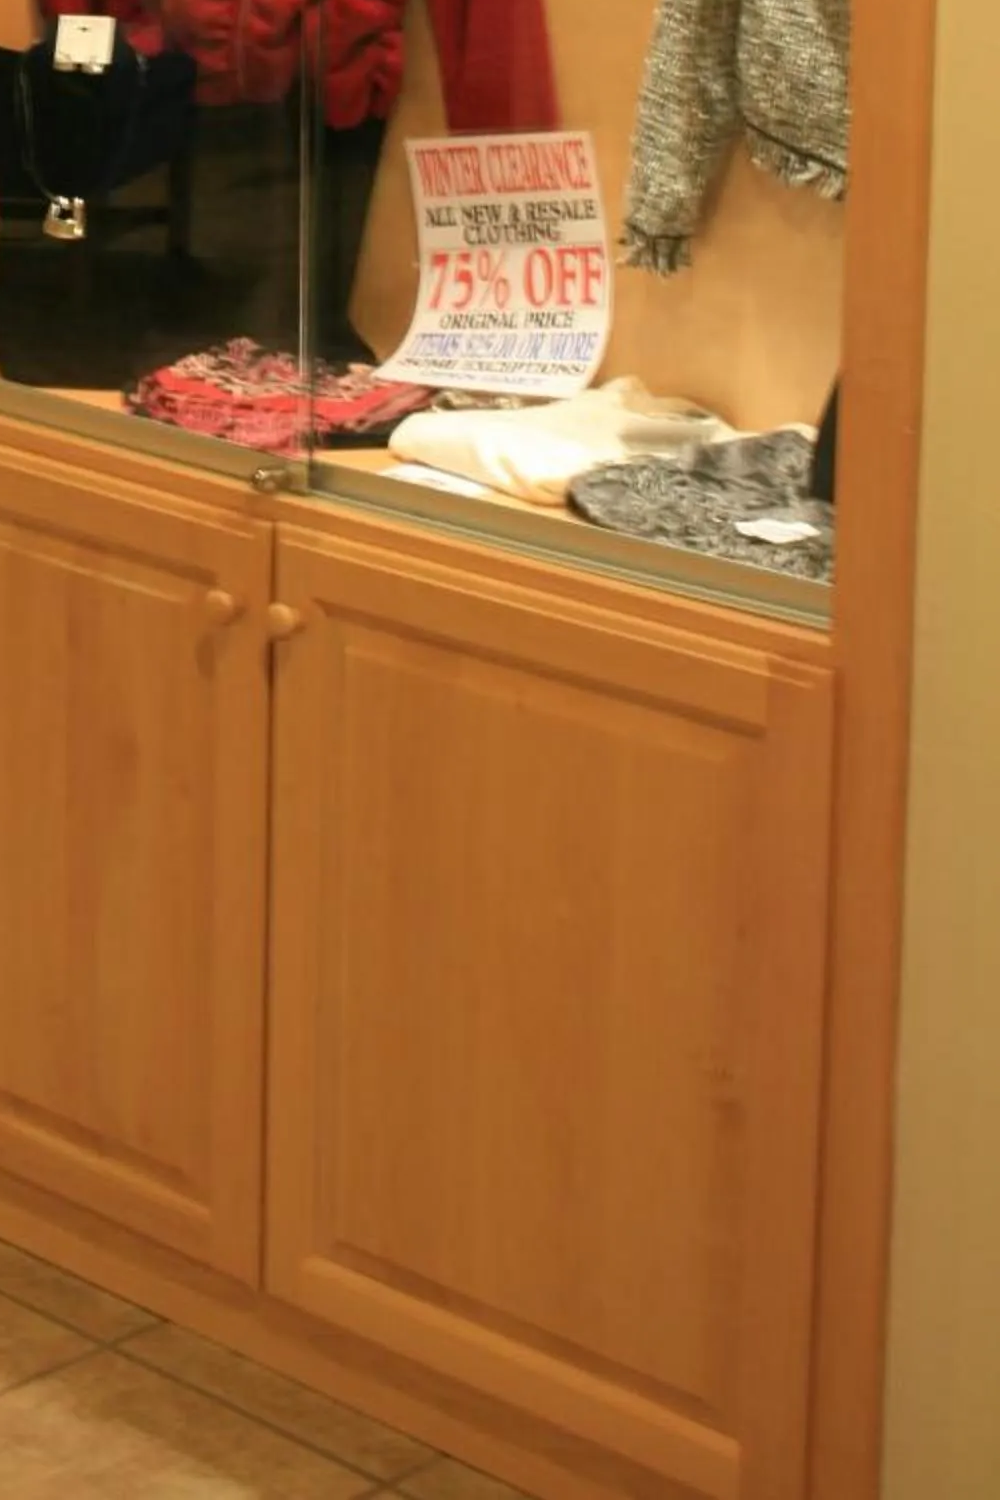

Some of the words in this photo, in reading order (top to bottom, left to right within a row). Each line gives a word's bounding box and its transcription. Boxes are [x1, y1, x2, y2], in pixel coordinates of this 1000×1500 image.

[415, 146, 487, 197] WINTER
[488, 139, 592, 193] CLEARANCE
[425, 204, 457, 227] ALL
[461, 202, 503, 226] NEW
[508, 202, 522, 224] &
[525, 199, 597, 222] RESALE
[463, 223, 562, 246] CLOTHING
[428, 248, 511, 310] 75%
[523, 245, 605, 308] OFF
[439, 311, 517, 330] ORIGINAL
[523, 310, 575, 329] PRICE
